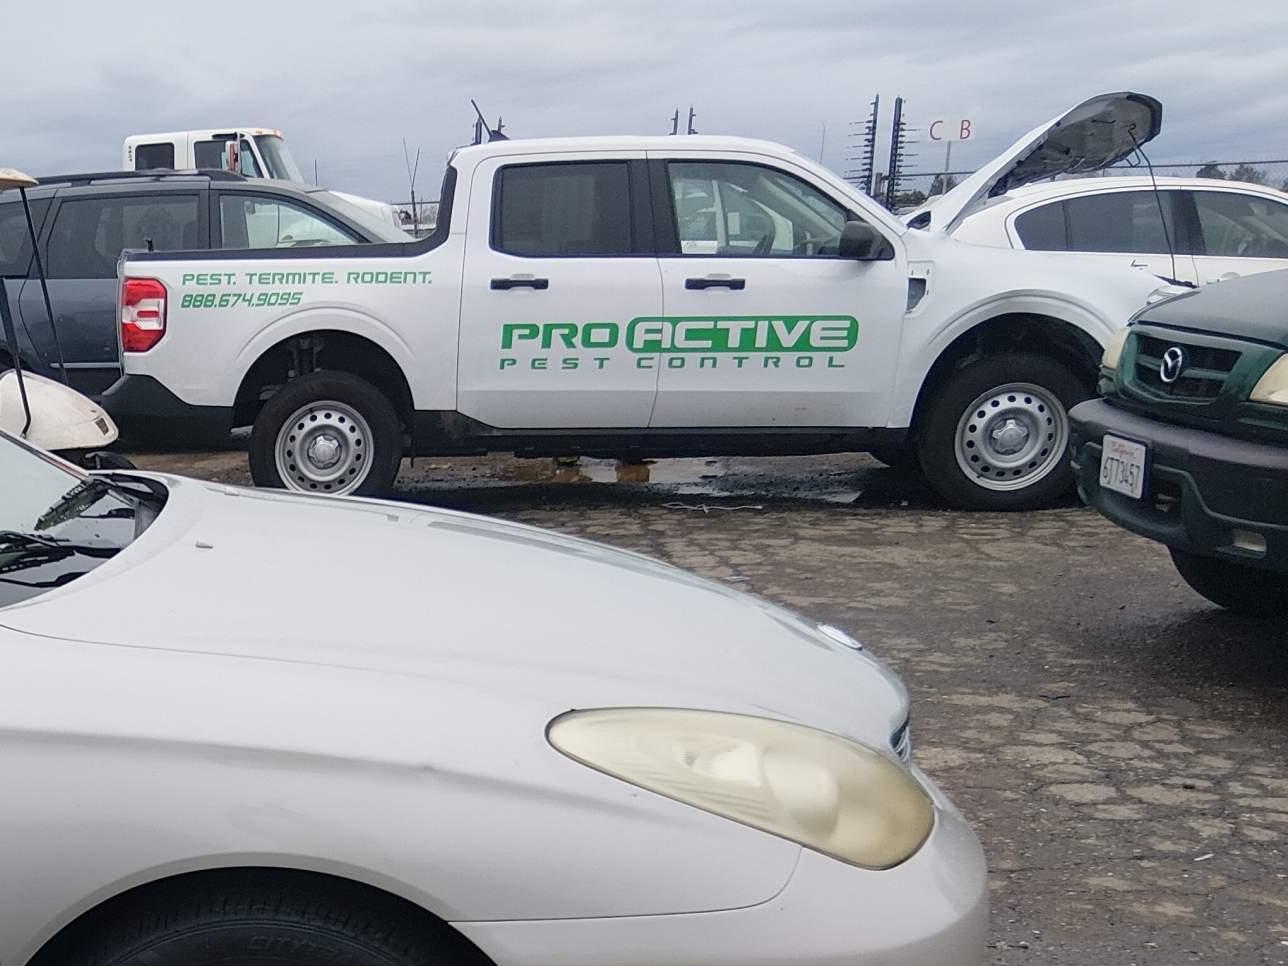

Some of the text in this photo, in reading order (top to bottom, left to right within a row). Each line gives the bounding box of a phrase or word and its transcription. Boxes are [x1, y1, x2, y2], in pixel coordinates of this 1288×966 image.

[929, 119, 972, 141] C B
[181, 271, 433, 287] PEST. TERMITE. RODENT.
[180, 292, 303, 308] 888.674.9095
[498, 354, 846, 371] PEST CONTROL
